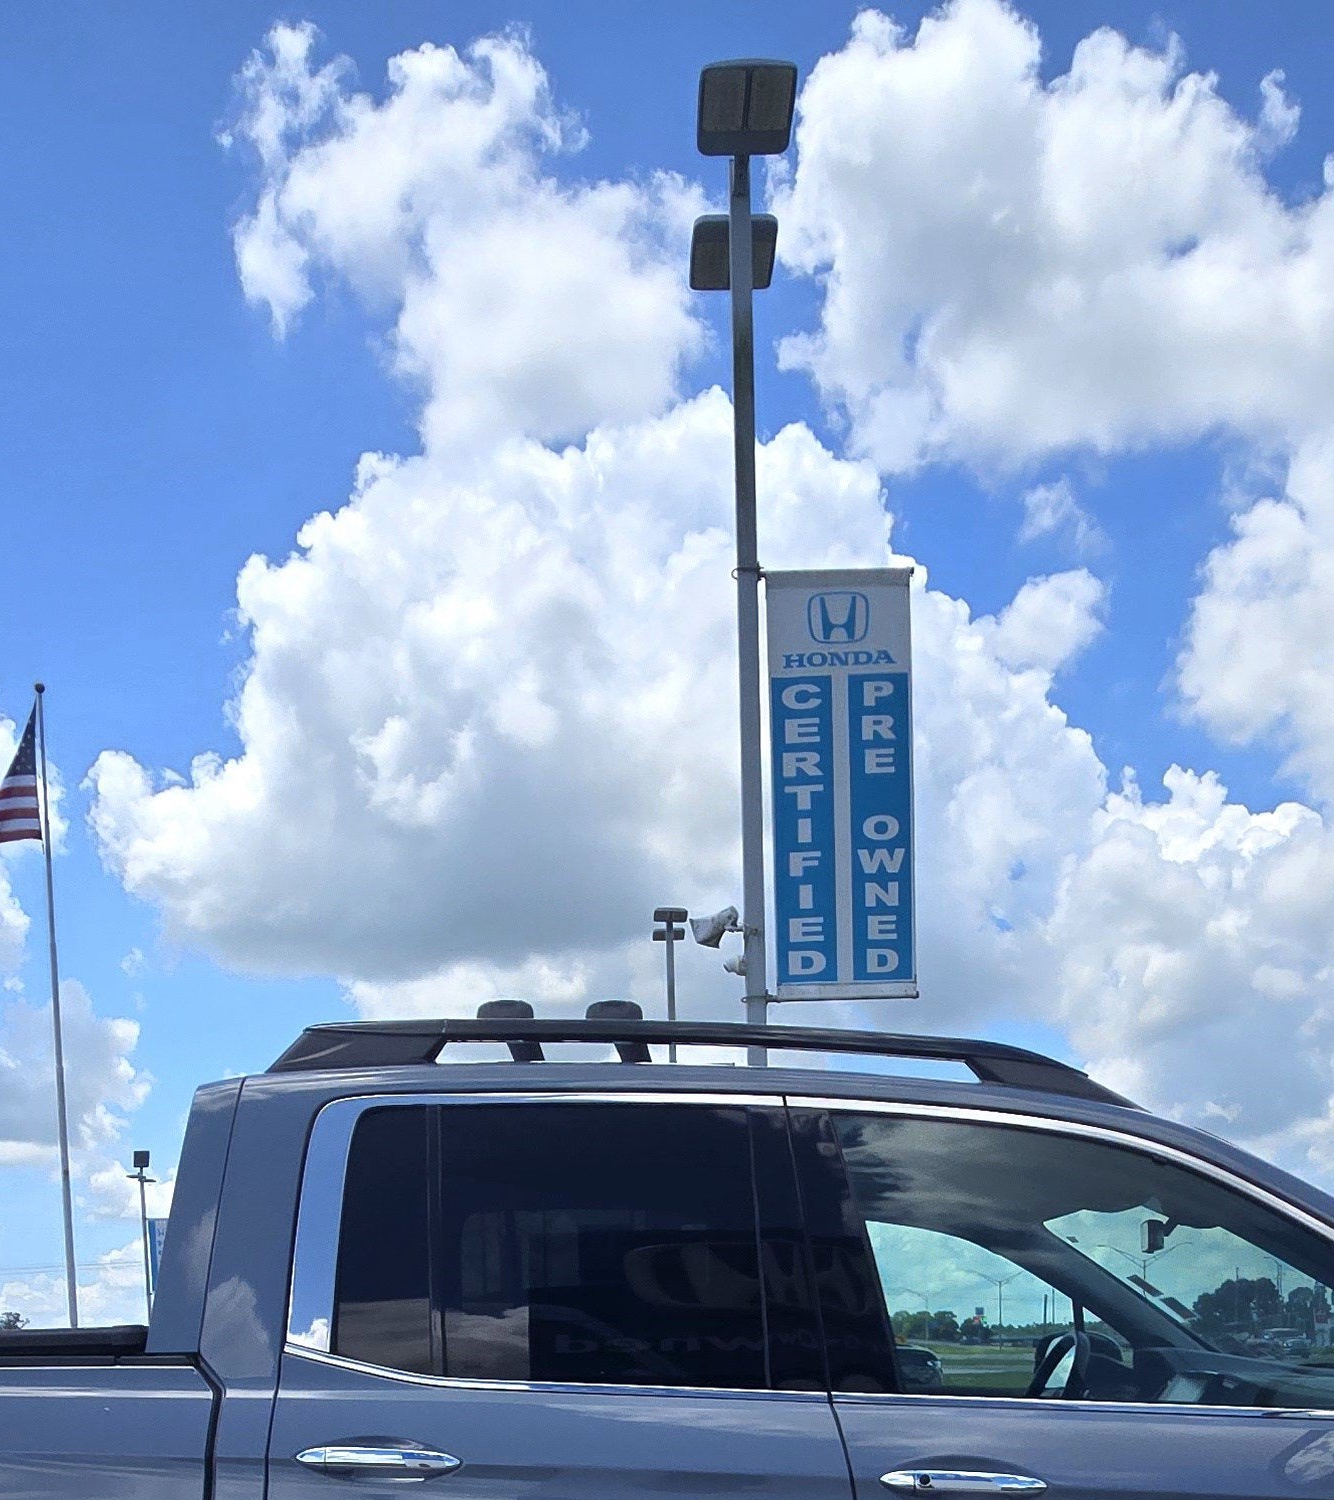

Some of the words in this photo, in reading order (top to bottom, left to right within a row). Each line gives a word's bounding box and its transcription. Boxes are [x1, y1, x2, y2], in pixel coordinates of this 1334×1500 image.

[782, 651, 896, 669] HONDA
[861, 681, 898, 775] PRE
[781, 683, 828, 977] CERTIFIED
[856, 814, 906, 976] OWNED
